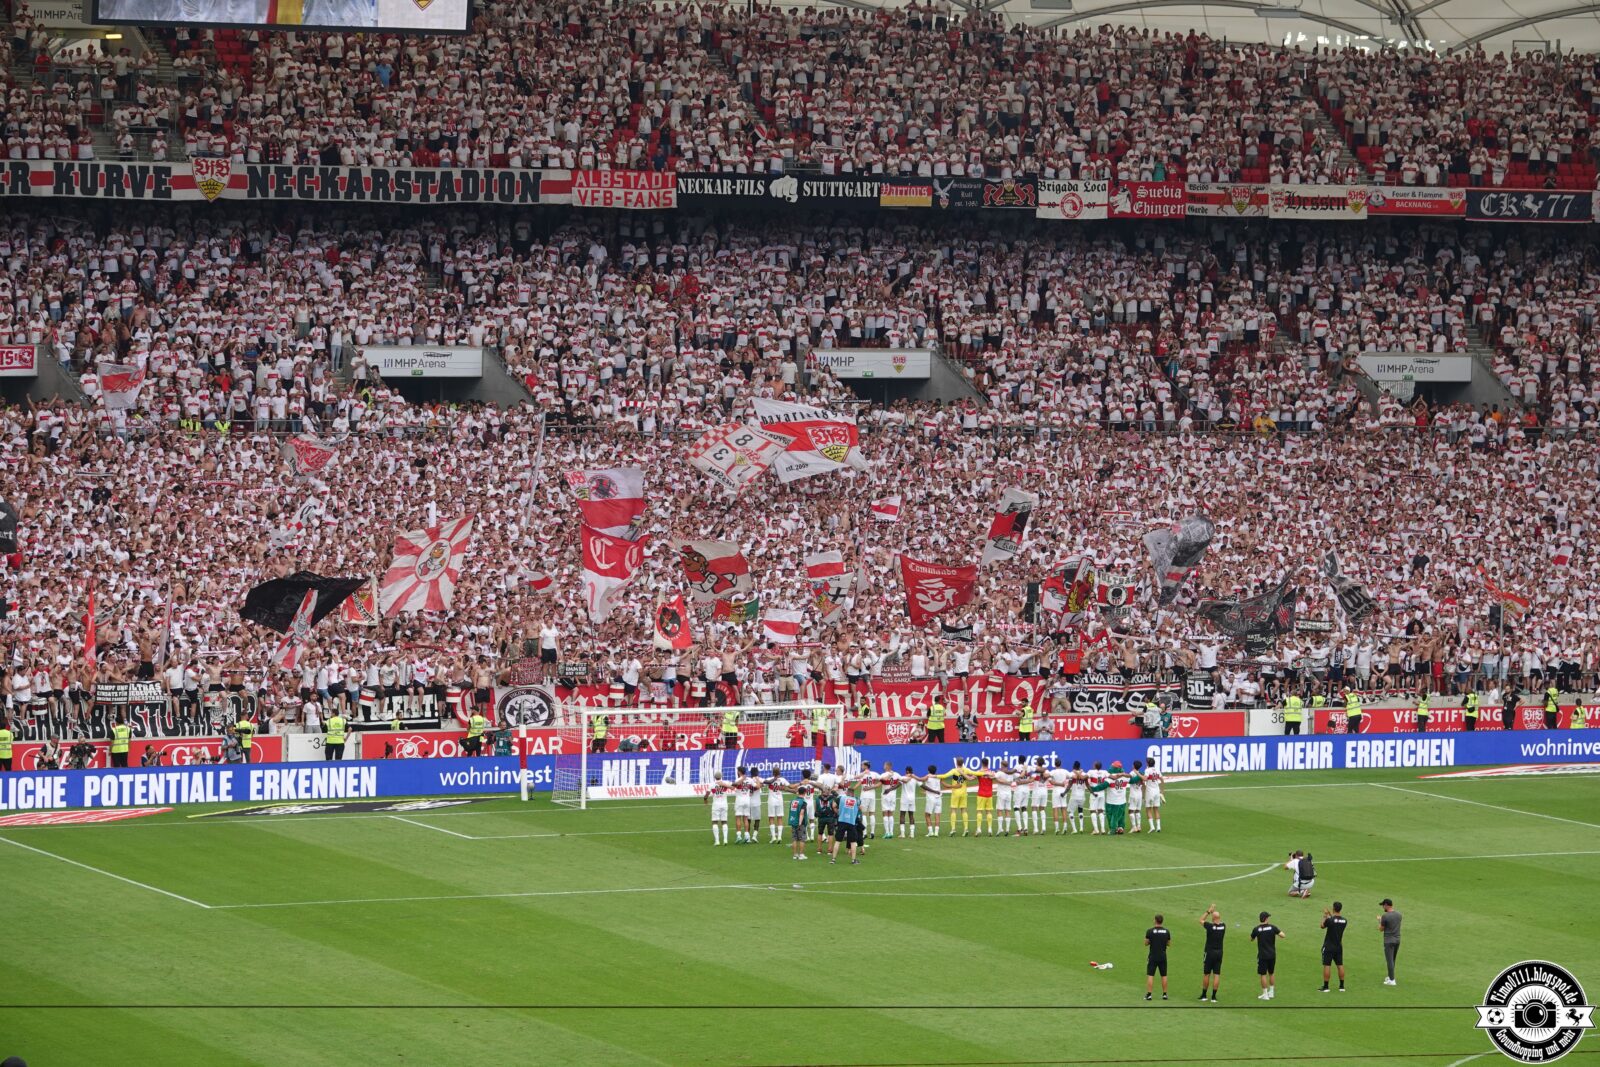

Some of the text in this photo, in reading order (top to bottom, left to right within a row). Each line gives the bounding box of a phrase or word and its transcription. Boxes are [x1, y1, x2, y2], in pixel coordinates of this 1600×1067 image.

[54, 163, 171, 199] KURVE
[247, 166, 541, 202] NECKARSTADION
[575, 171, 675, 187] ALBSTADT
[678, 179, 880, 198] NECKAR-FILS STUTTGART
[1038, 182, 1106, 194] Brigada Loca
[1136, 185, 1182, 199] Suebia
[577, 190, 672, 207] VFB-FANS
[1396, 201, 1432, 209] BACKNANG
[1548, 195, 1575, 217] 77
[1133, 202, 1184, 217] Ehingen
[395, 359, 446, 368] MHP Arena
[831, 356, 854, 366] MHP
[1388, 365, 1434, 373] MHP Arena
[1187, 680, 1214, 696] 50+
[1147, 739, 1455, 773] GEMEINSAM MEHR ERREICHEN
[602, 759, 650, 787] MUT
[661, 757, 690, 785] ZU
[84, 771, 233, 807] POTENTIALE
[250, 766, 376, 801] ERKENNEN
[607, 786, 658, 797] WINAMAX
